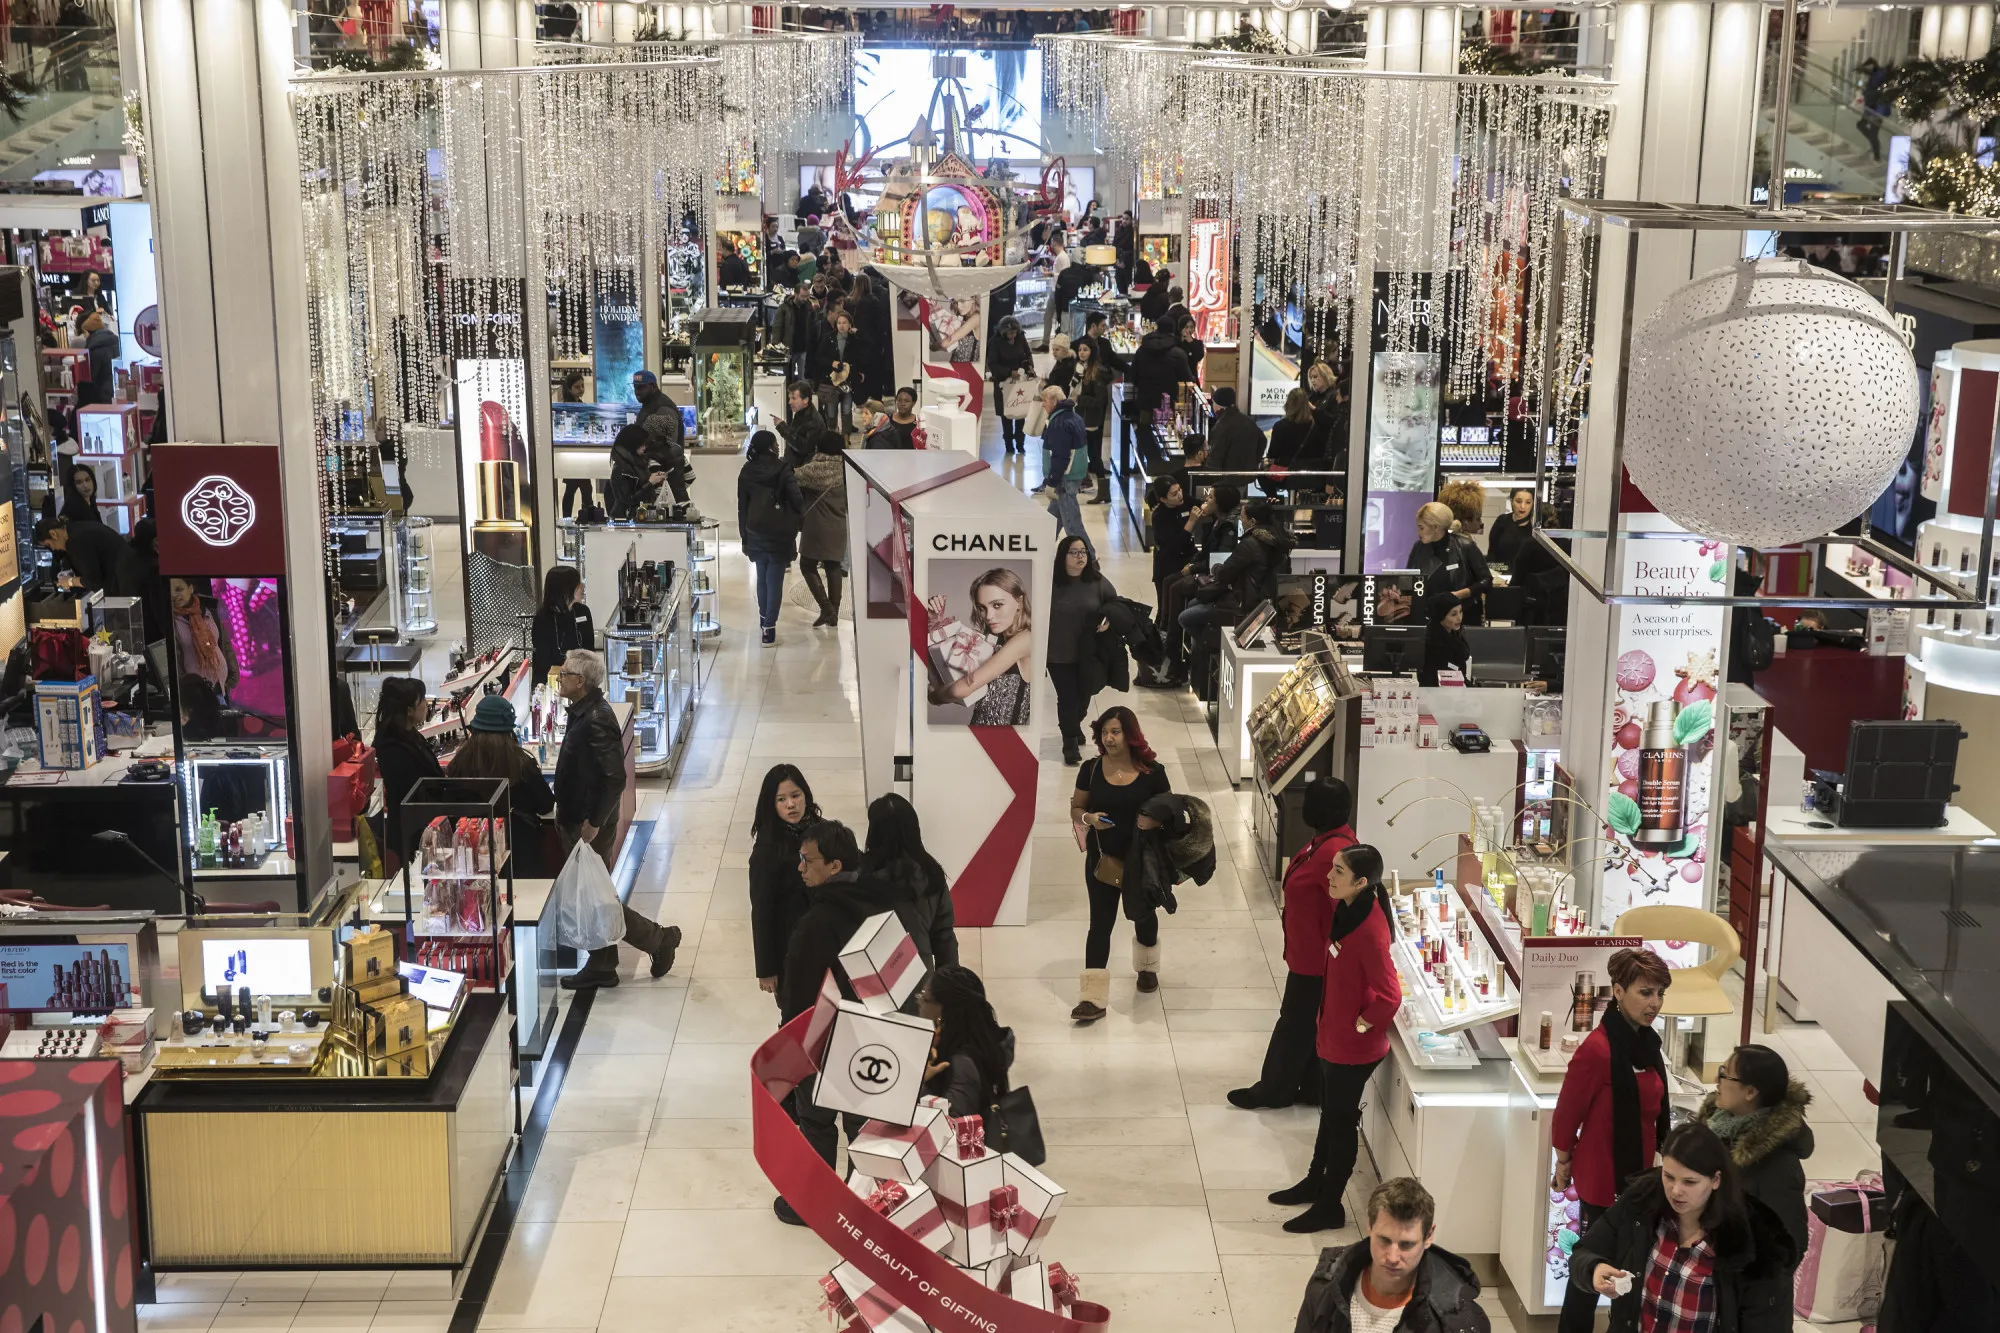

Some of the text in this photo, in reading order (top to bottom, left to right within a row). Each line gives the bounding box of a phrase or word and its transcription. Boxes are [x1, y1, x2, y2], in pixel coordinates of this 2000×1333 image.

[1752, 187, 1769, 201] Dio
[600, 305, 637, 314] HOLIDAY
[600, 314, 640, 322] WONDER
[932, 533, 1038, 552] CHANEL
[1635, 560, 1700, 585] Beauty
[1414, 576, 1425, 597] POP
[1313, 576, 1325, 625] CONTOUR
[1363, 575, 1375, 625] HIGHLIGHT
[1632, 612, 1694, 624] A season of
[1631, 625, 1713, 639] sweet surprises.
[1642, 751, 1684, 759] CLARINS
[1, 960, 17, 968] Red
[18, 960, 25, 968] is
[1531, 952, 1579, 965] Daily Duo
[836, 1212, 998, 1333] THE BEAUTY OF GIFTING
